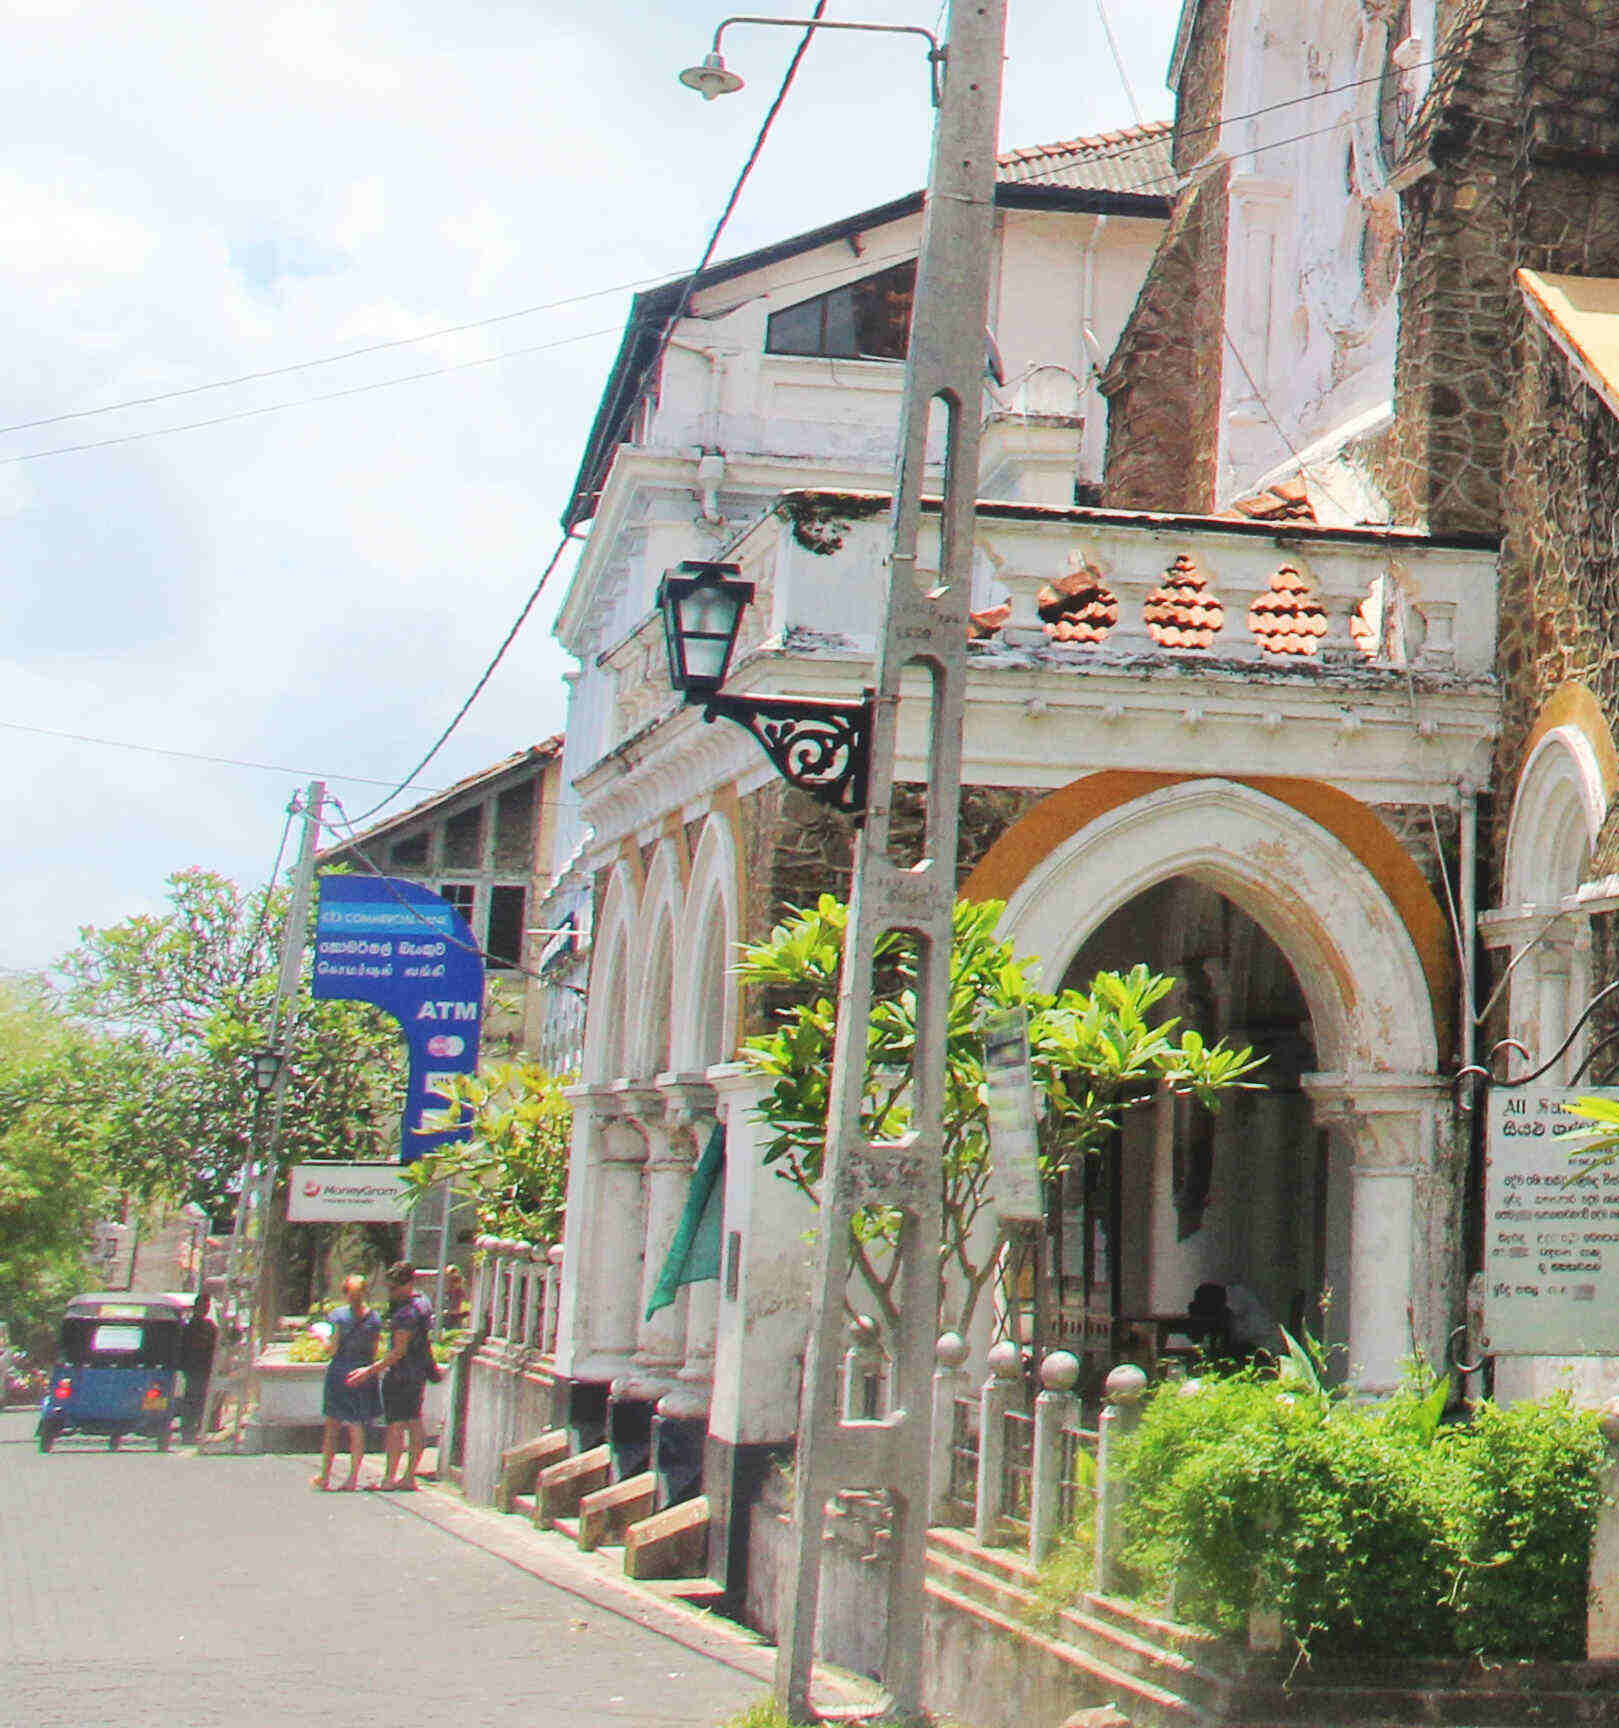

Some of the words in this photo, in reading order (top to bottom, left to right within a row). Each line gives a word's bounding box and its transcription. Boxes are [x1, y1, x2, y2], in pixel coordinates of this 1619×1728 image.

[416, 1000, 478, 1020] ATM
[1503, 1098, 1526, 1115] All
[323, 1185, 397, 1197] MoneyGram
